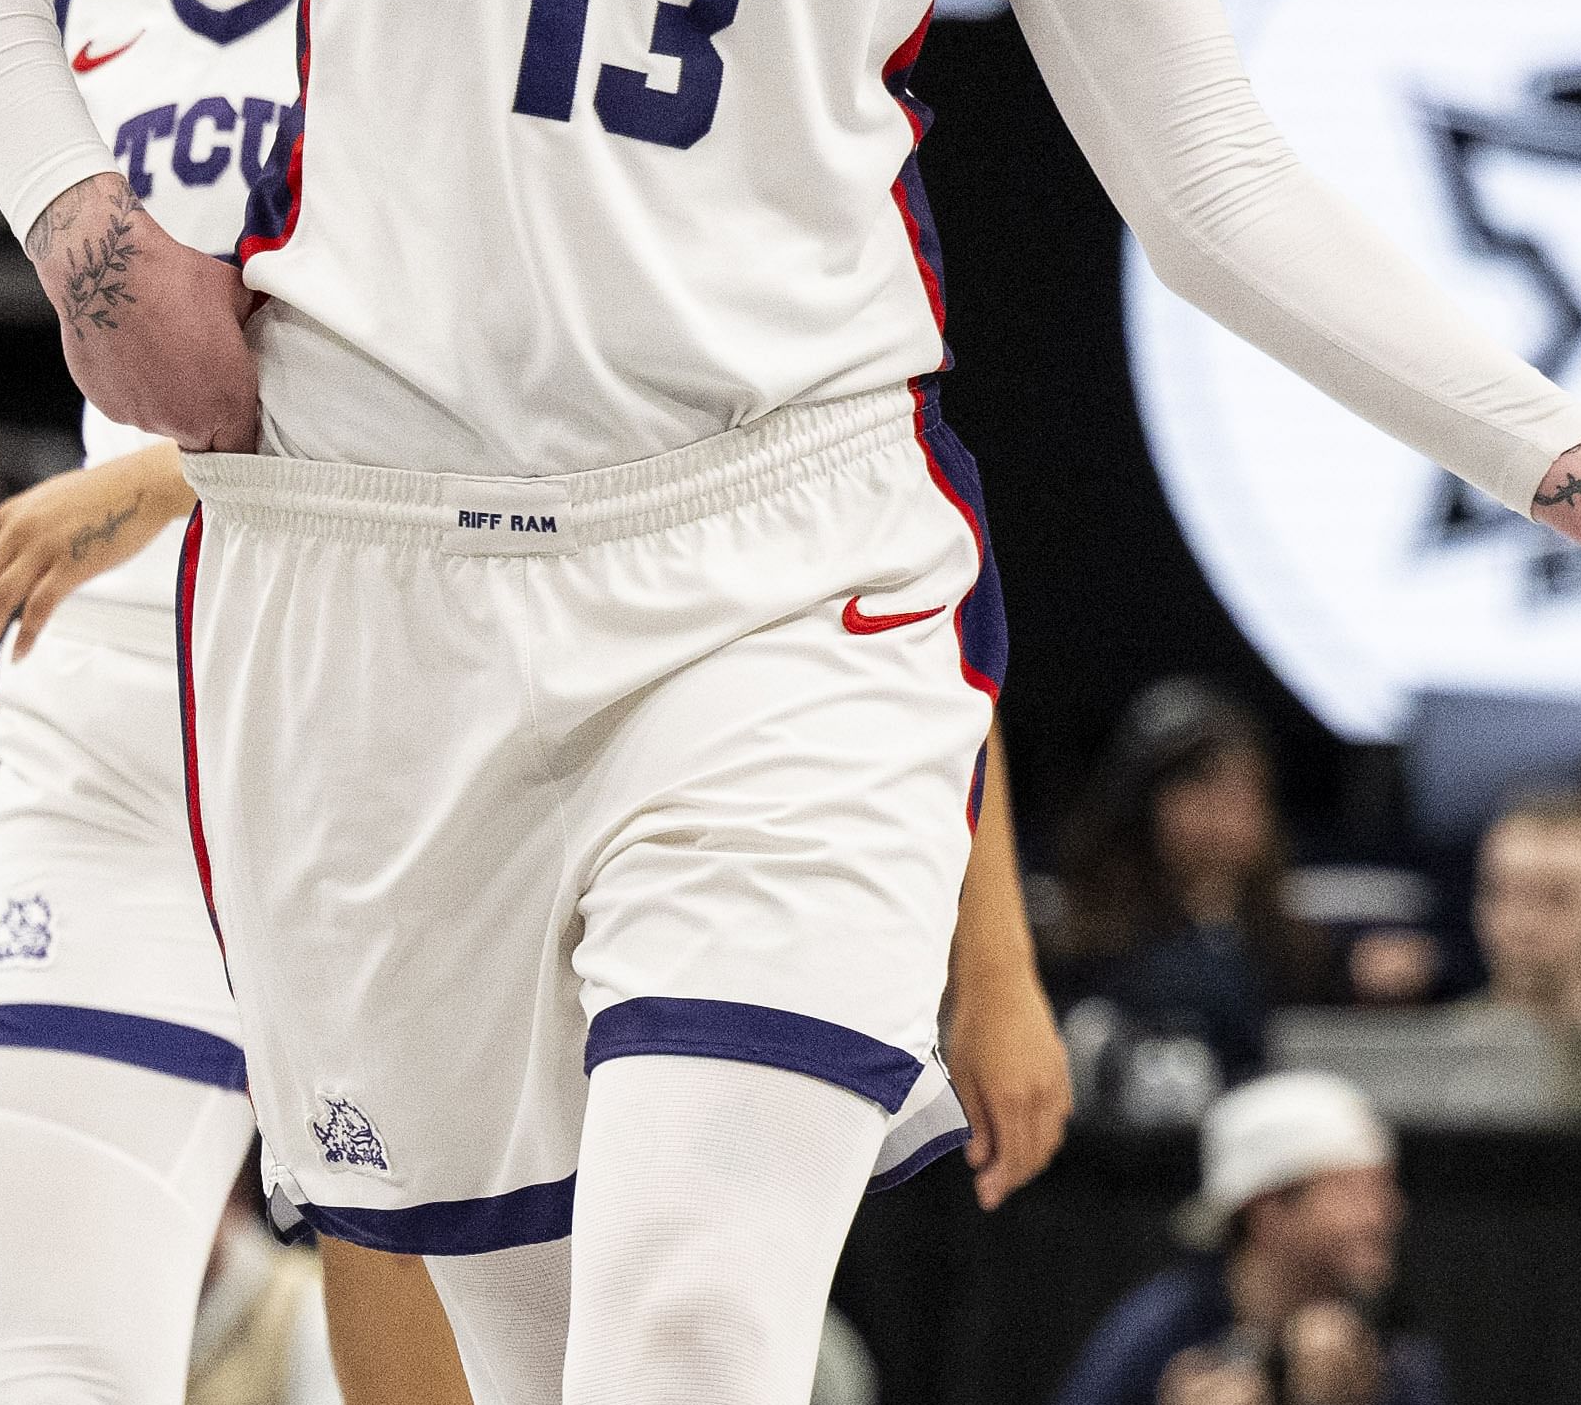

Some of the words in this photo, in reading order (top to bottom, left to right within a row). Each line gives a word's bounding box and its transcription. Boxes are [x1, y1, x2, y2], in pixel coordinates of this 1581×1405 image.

[114, 96, 292, 199] TCU
[458, 510, 502, 530] RIFF
[510, 514, 557, 533] RAM
